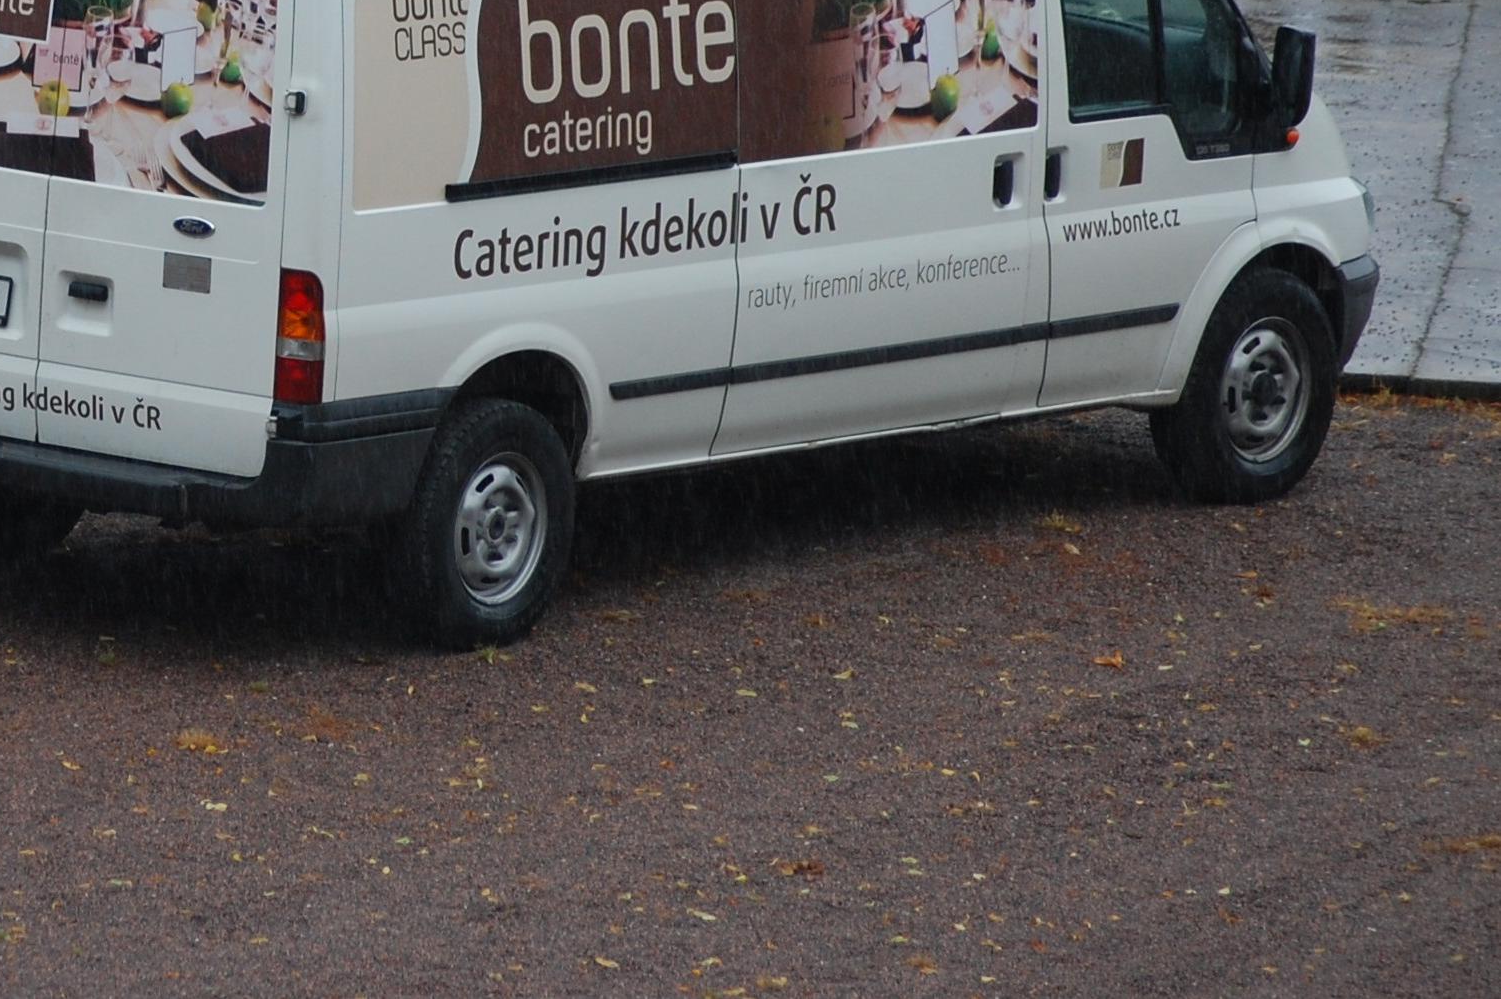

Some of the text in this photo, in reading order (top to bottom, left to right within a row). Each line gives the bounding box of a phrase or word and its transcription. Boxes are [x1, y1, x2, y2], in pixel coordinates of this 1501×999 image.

[394, 23, 467, 62] CLASS
[523, 106, 653, 158] catering
[454, 173, 837, 280] Catering kdekoli v ČR
[1062, 208, 1181, 244] www.bonte.cz
[747, 282, 797, 312] rauty,
[803, 268, 865, 301] firemní
[868, 268, 911, 292] akce,
[23, 383, 104, 422] kdekoli
[110, 406, 125, 424] v
[132, 398, 162, 431] ČR
